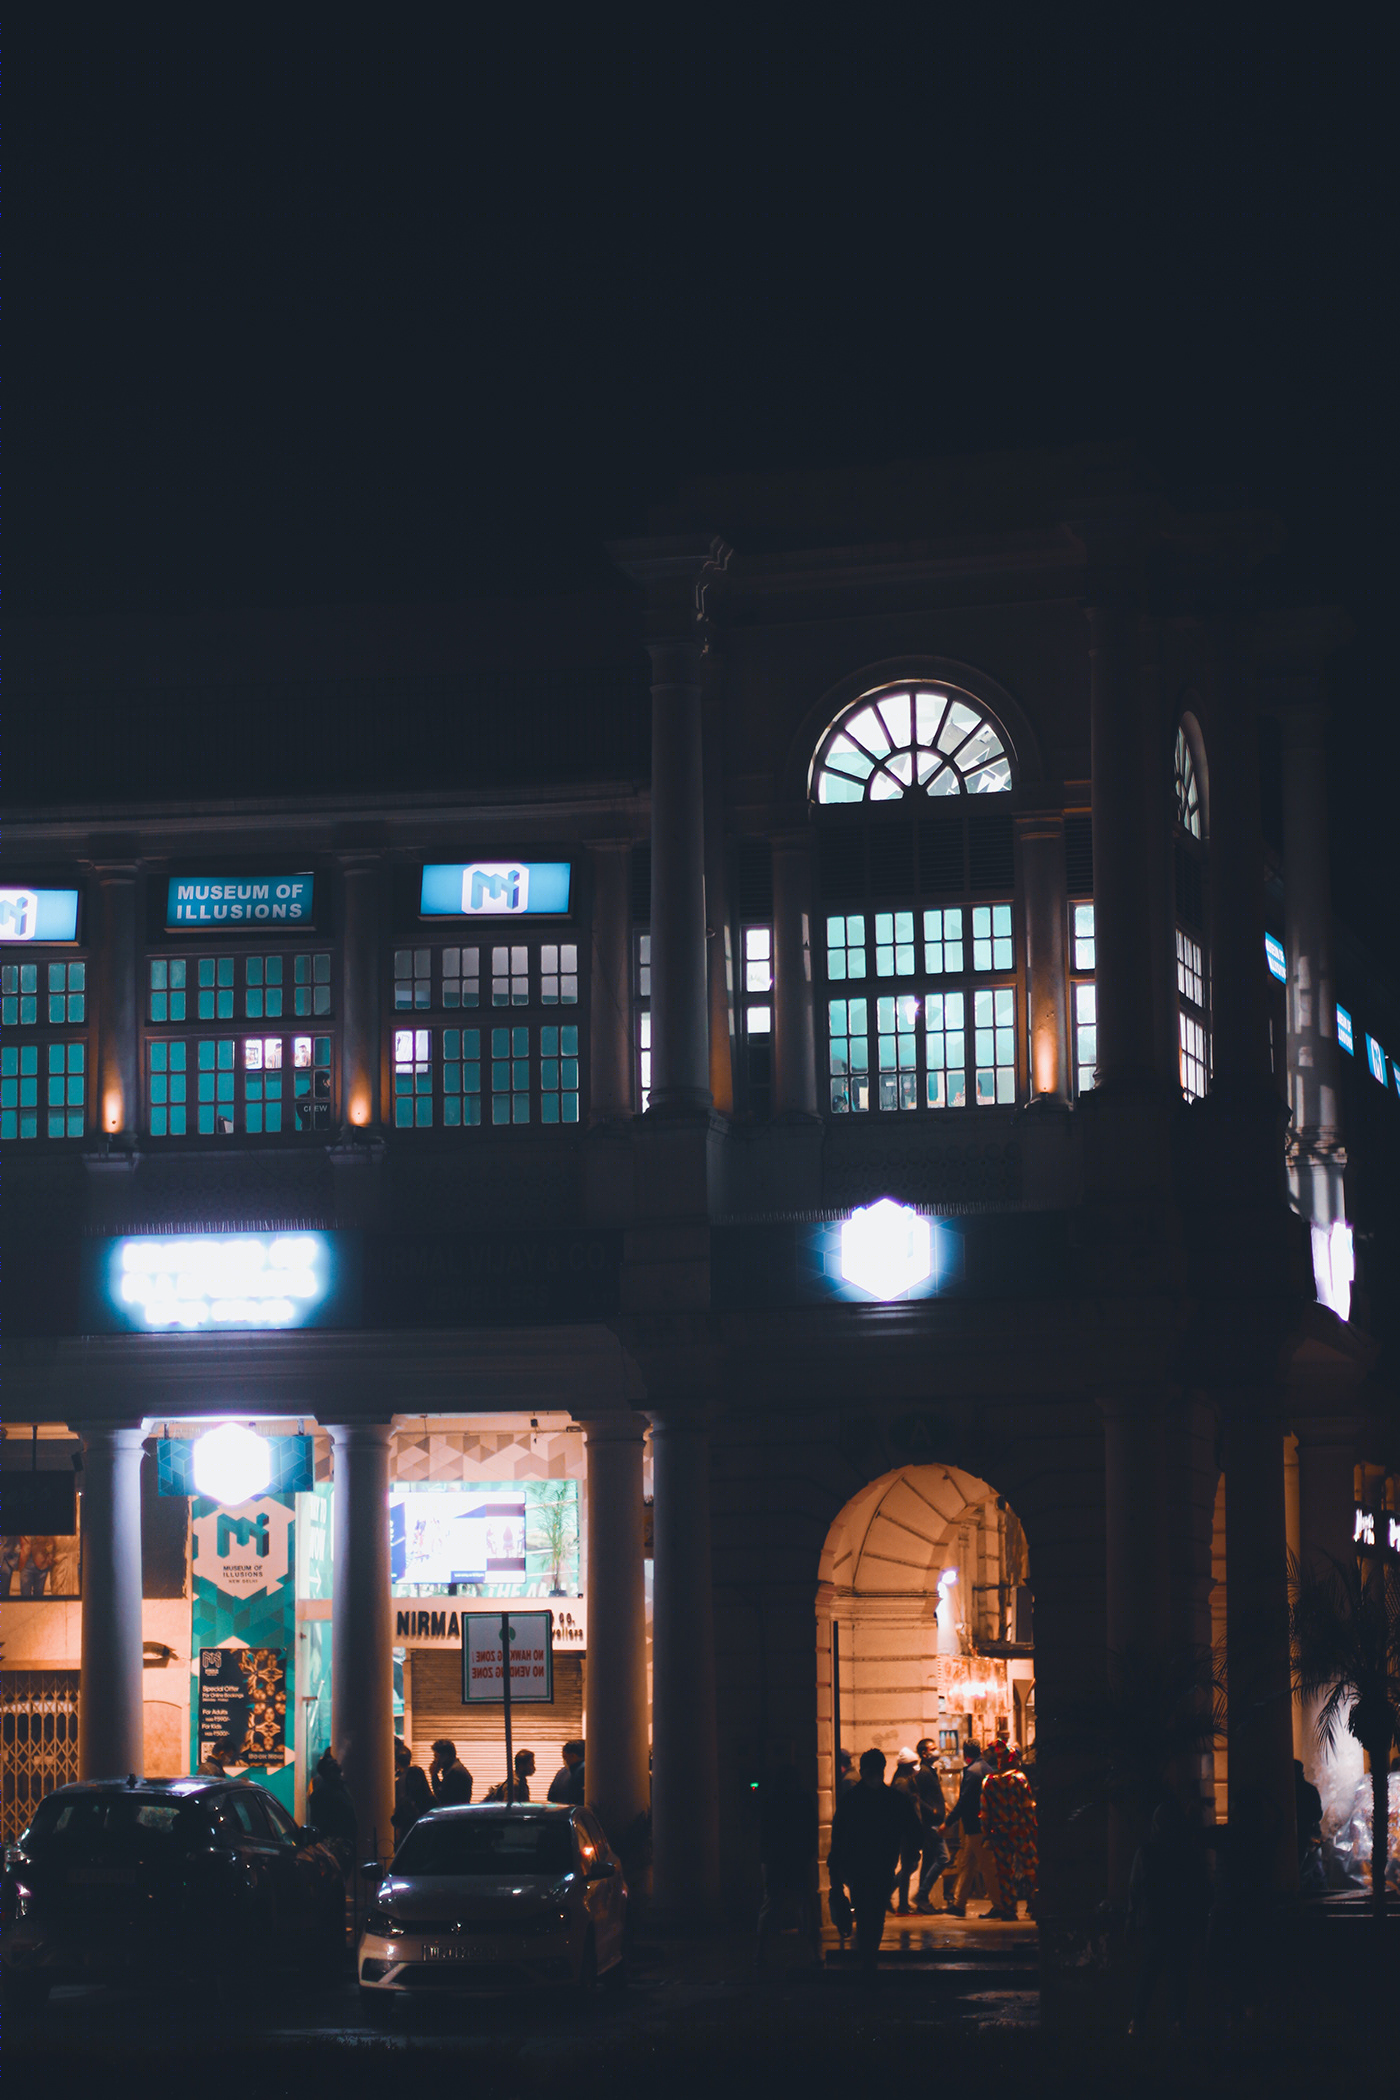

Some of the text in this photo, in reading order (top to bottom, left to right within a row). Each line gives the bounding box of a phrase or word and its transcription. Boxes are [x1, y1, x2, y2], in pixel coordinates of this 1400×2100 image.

[178, 883, 304, 900] MUSEUM OF
[176, 903, 303, 920] ILLUSIONS
[366, 1245, 462, 1276] NIRMAL
[468, 1243, 539, 1275] VIJAY
[546, 1246, 560, 1273] &
[426, 1284, 551, 1311] JEWELLERS
[396, 1611, 460, 1636] NIRMA
